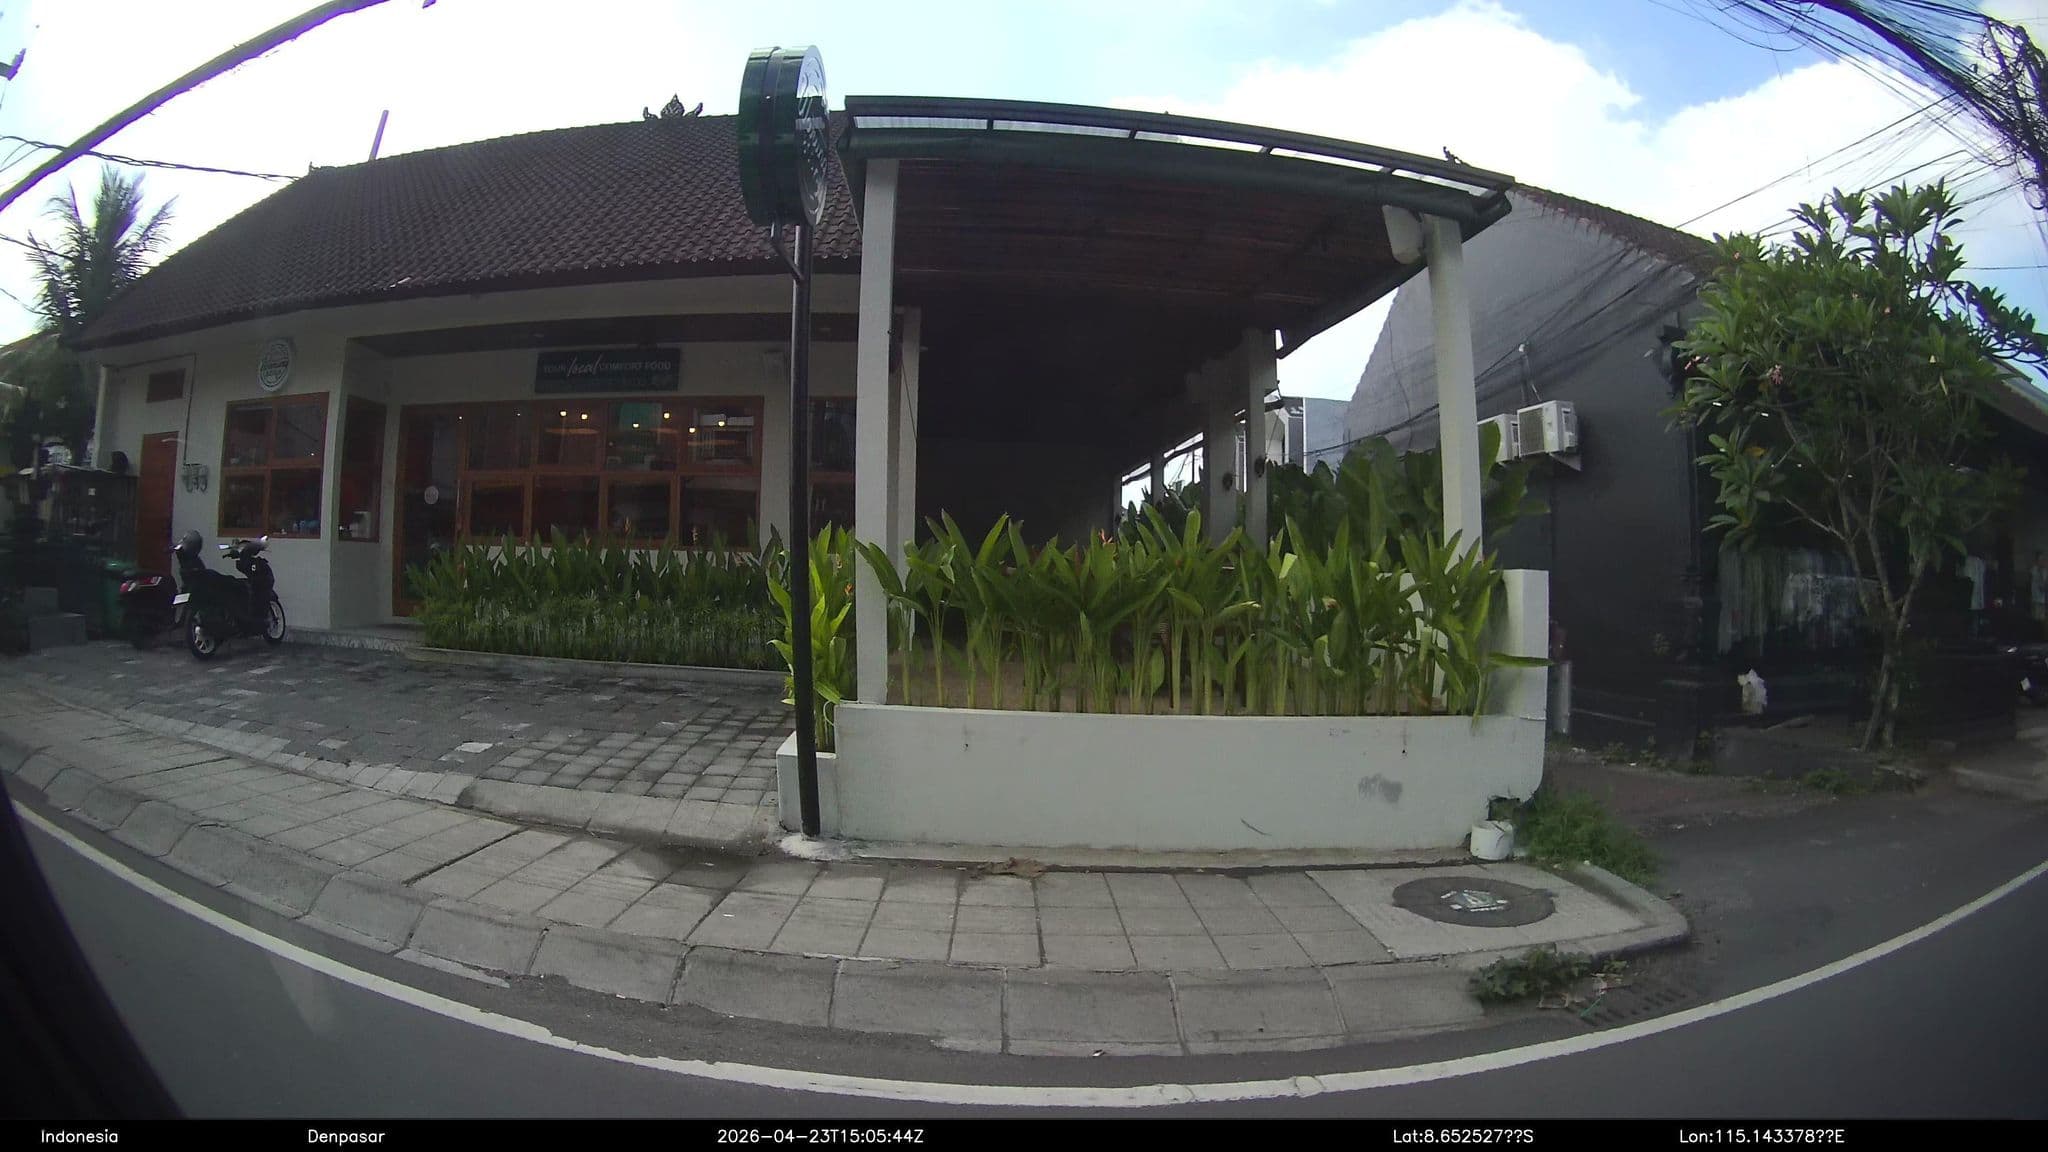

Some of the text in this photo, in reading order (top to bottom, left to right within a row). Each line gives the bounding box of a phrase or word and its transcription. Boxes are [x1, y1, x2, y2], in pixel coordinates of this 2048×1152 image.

[566, 352, 604, 377] local
[600, 360, 642, 372] COMFORT
[644, 359, 671, 370] FOOD
